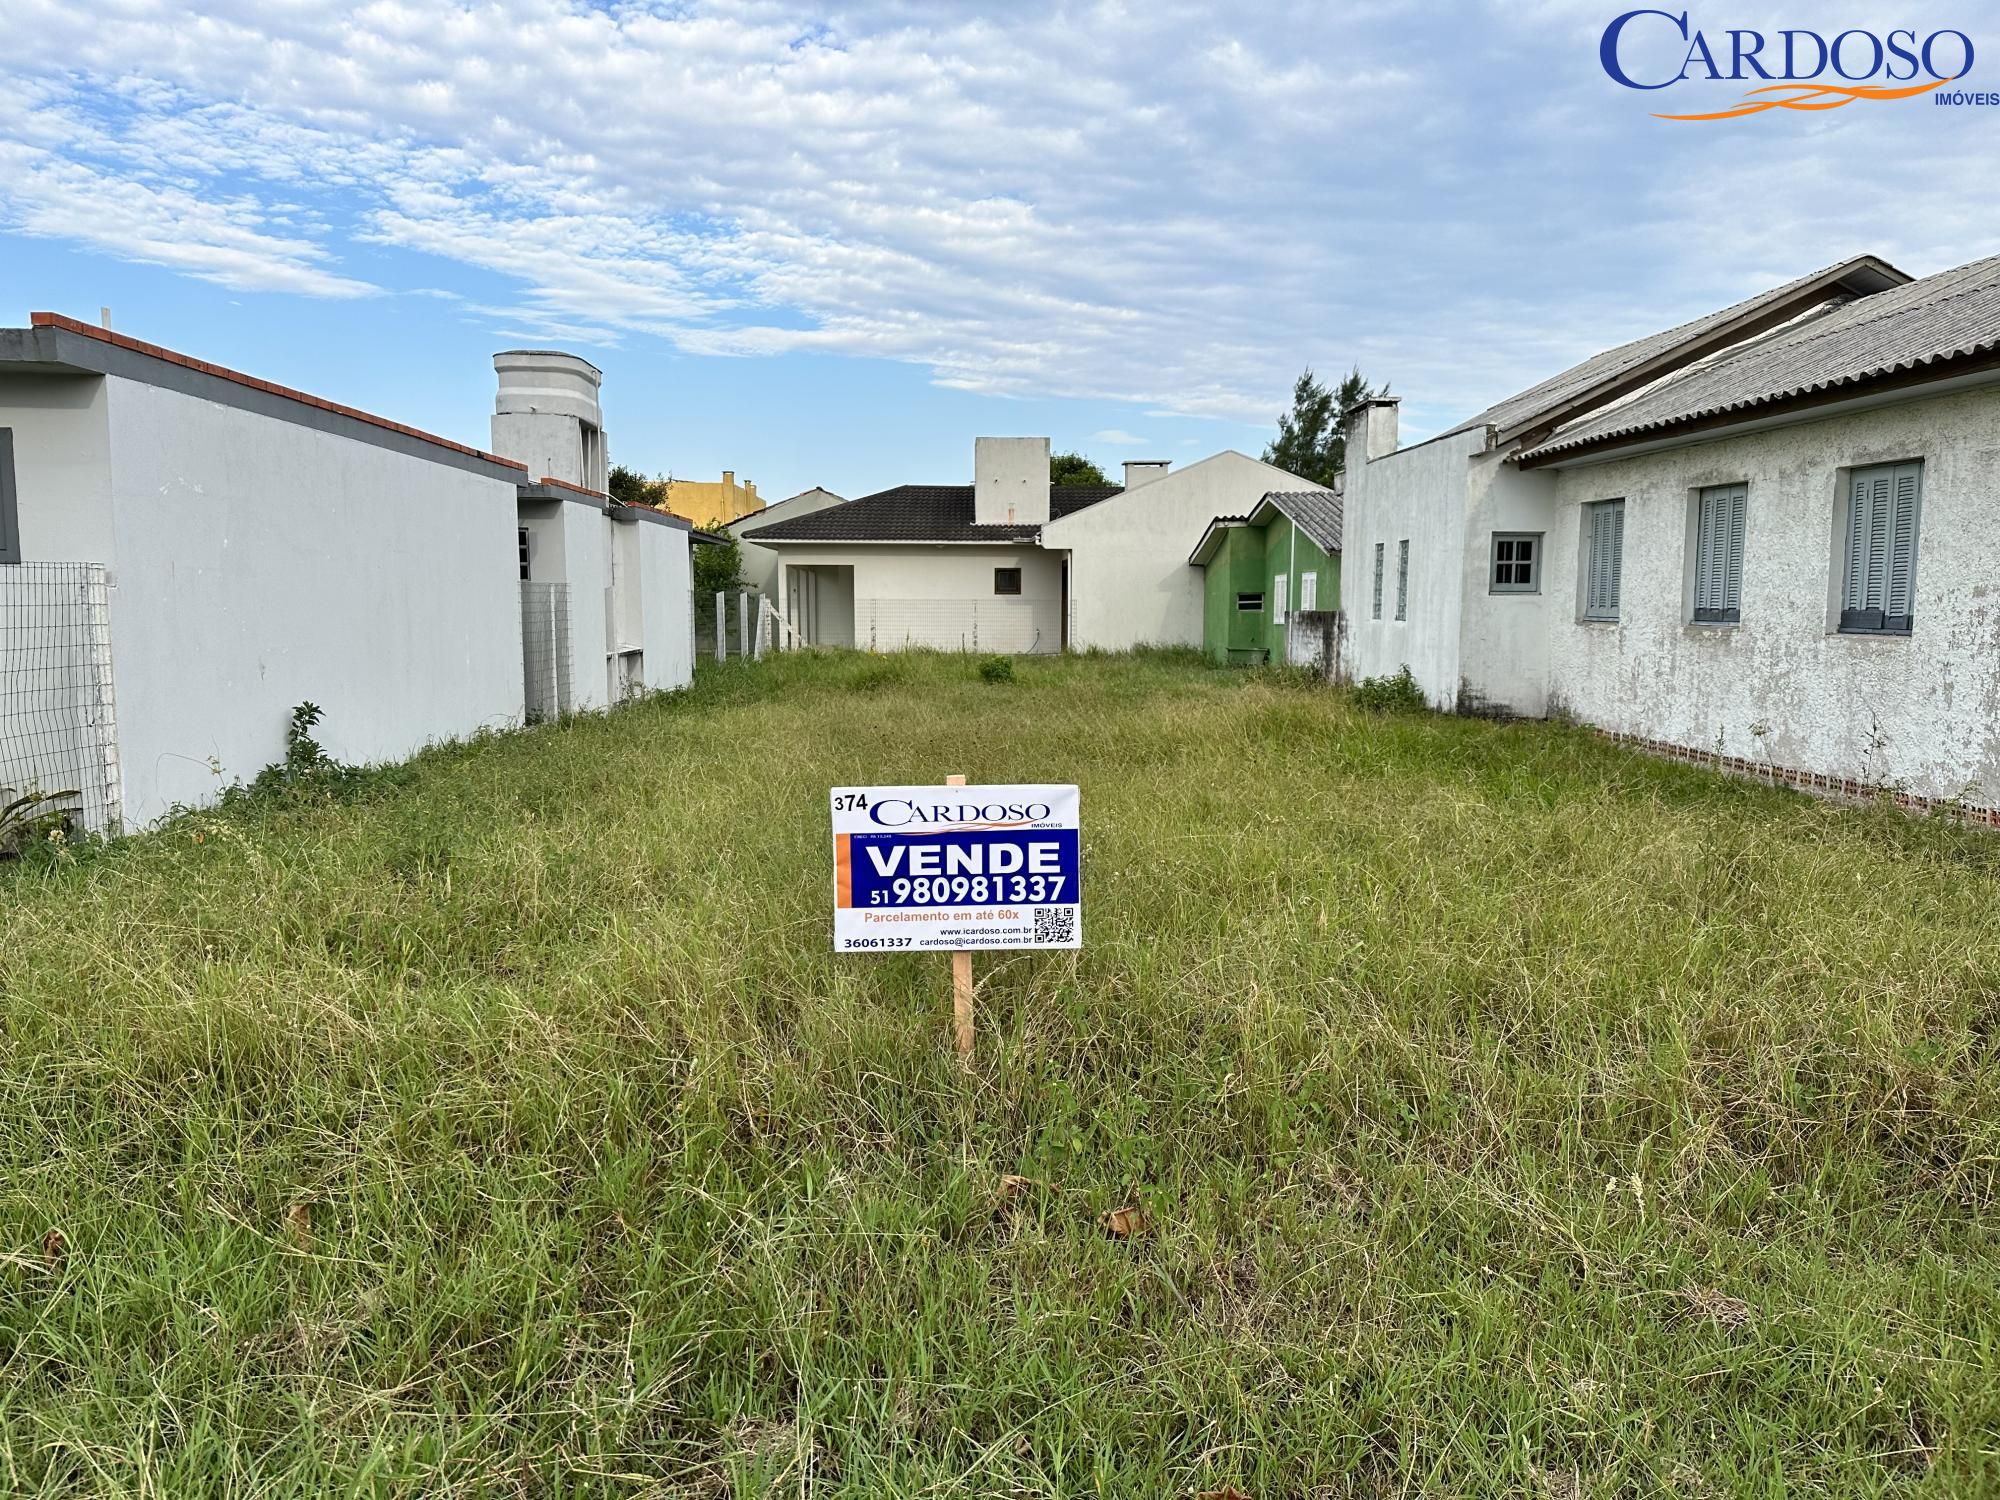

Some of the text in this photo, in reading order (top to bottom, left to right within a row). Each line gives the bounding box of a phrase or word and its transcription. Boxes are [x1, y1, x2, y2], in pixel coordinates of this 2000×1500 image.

[834, 794, 868, 812] 374
[869, 799, 1050, 826] CARDOSO
[865, 842, 1060, 877] VENDE
[870, 876, 1066, 905] 51 980981337
[864, 909, 1019, 924] Parcelamento em até 60x
[940, 926, 1033, 936] www.icardoso.com.br
[844, 936, 1033, 949] 36061337 cardoso@icardoso.com.br
